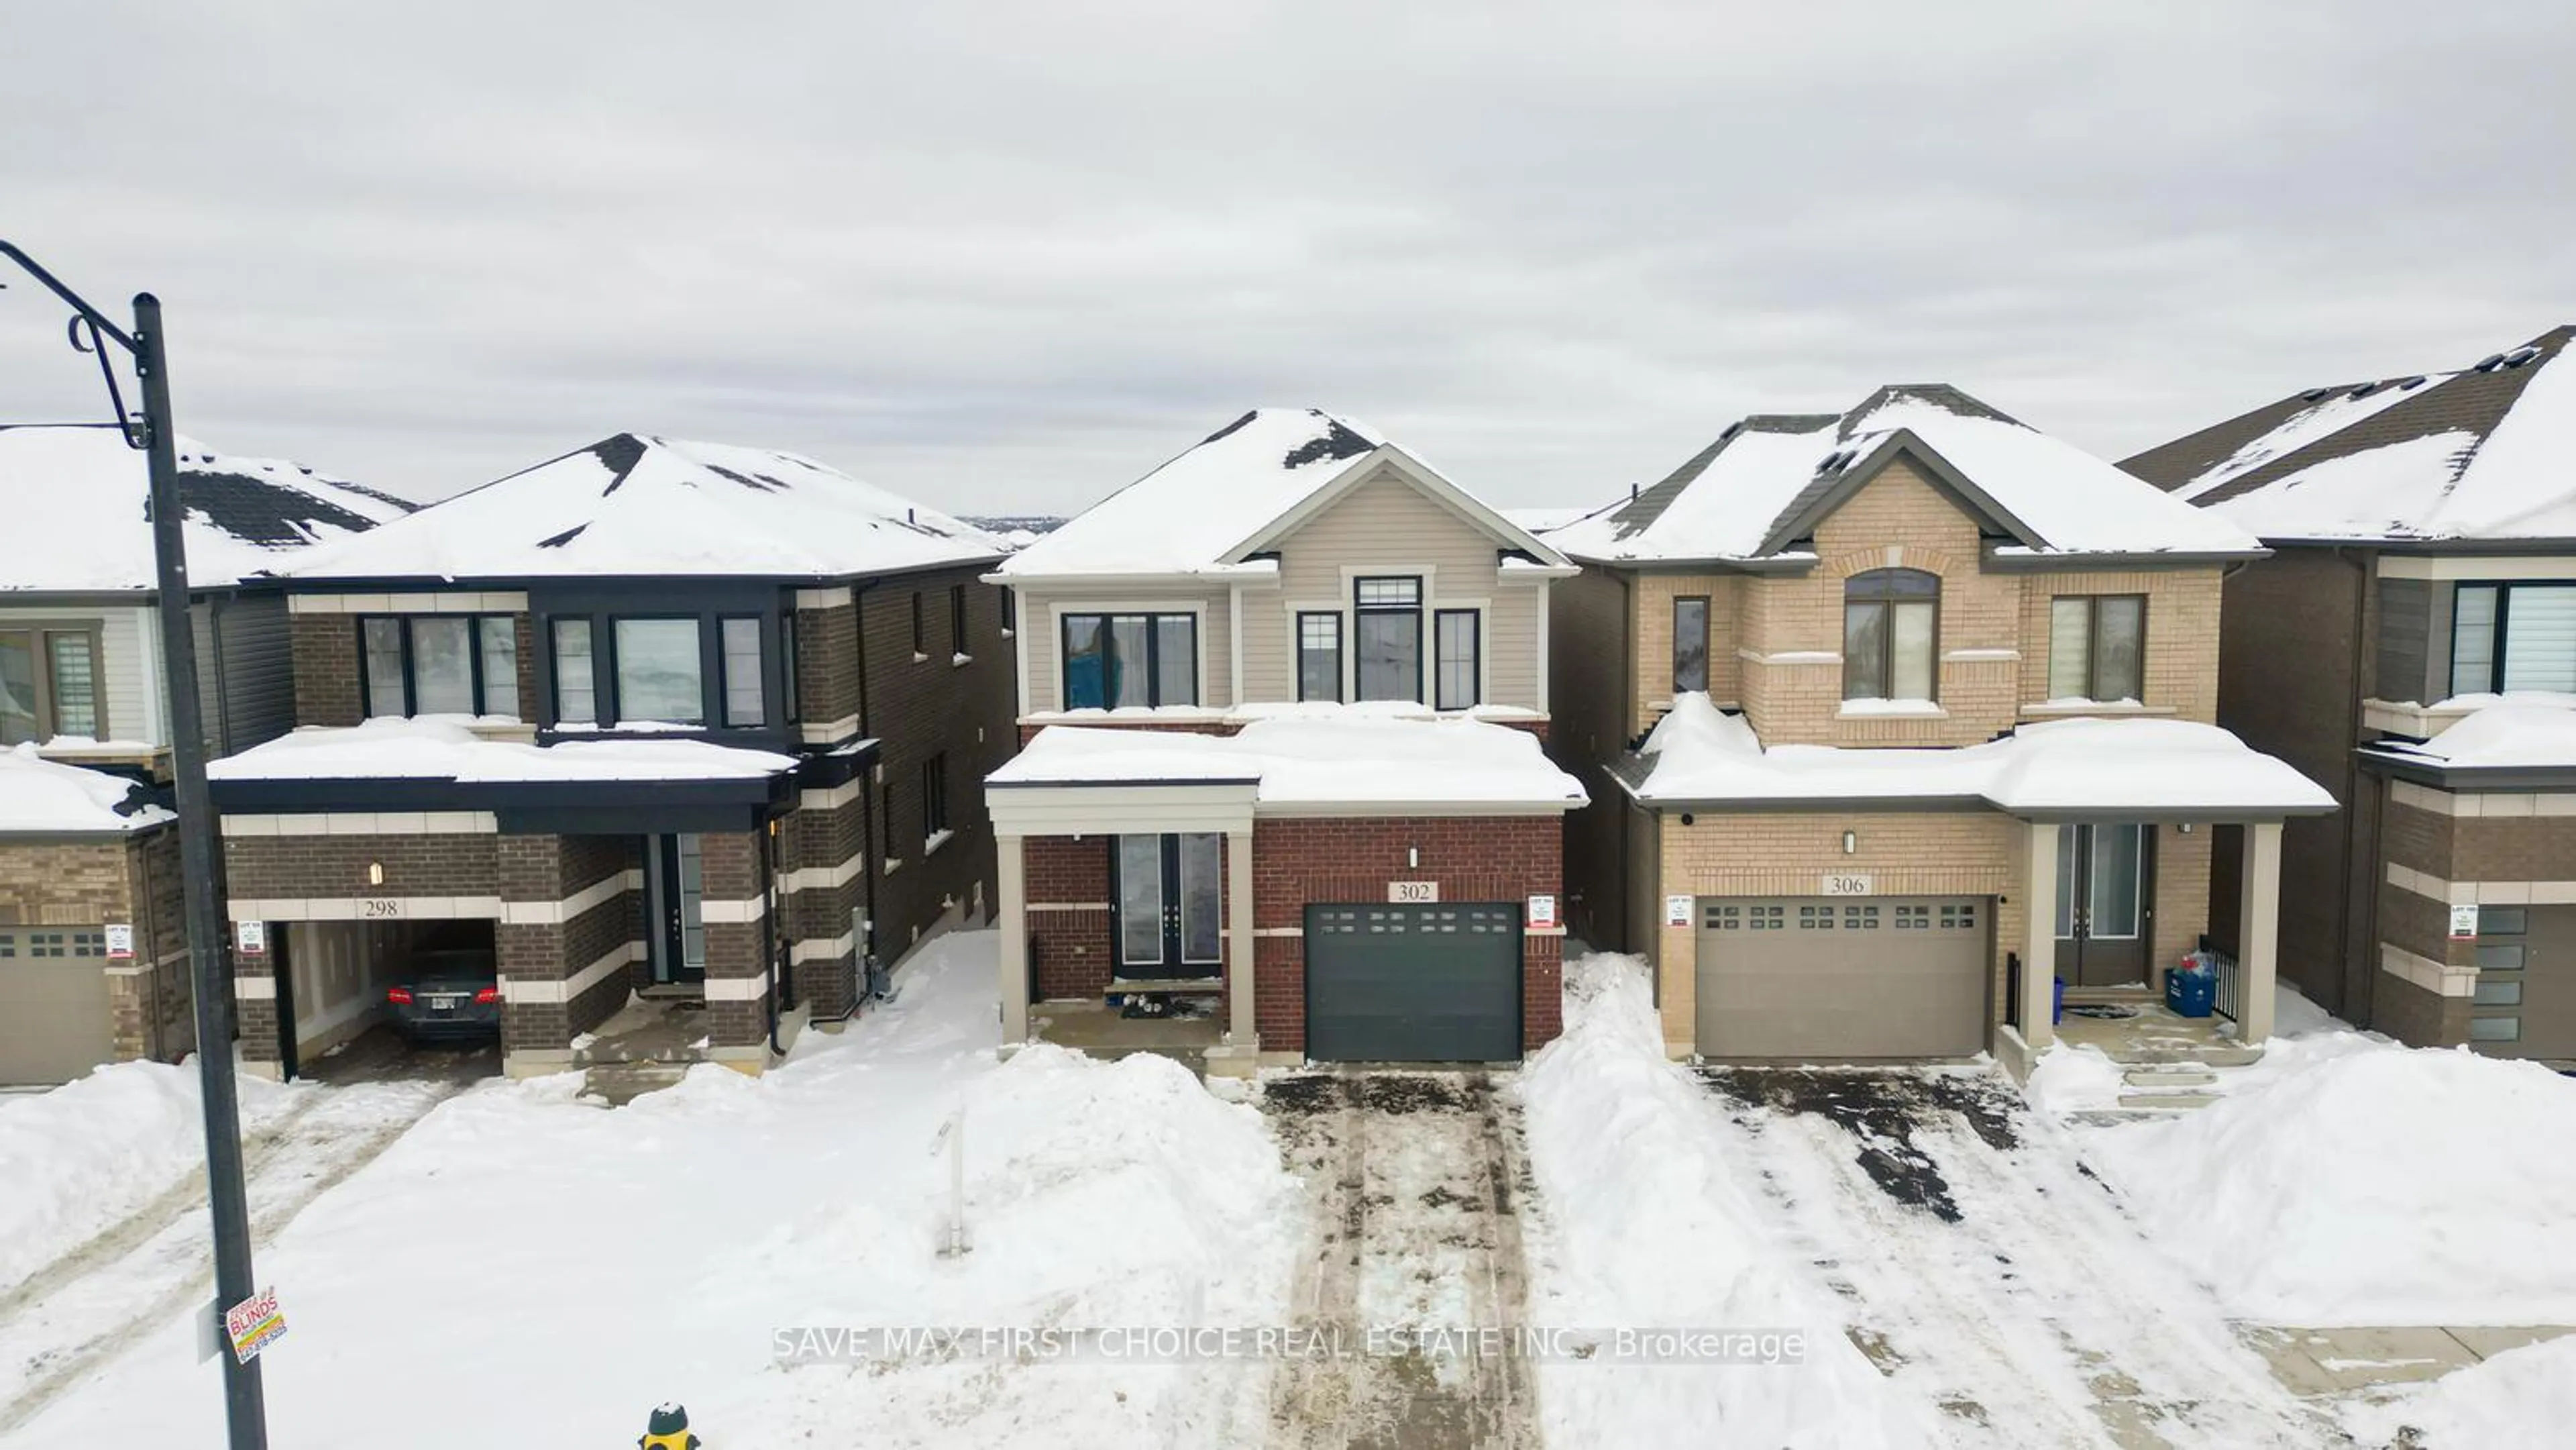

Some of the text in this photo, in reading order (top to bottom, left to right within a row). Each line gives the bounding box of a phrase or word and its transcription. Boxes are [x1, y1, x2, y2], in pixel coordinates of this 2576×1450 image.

[1399, 884, 1430, 900] 302
[1830, 877, 1864, 894] 306
[366, 900, 398, 917] 298
[230, 1296, 278, 1335] BLINDS
